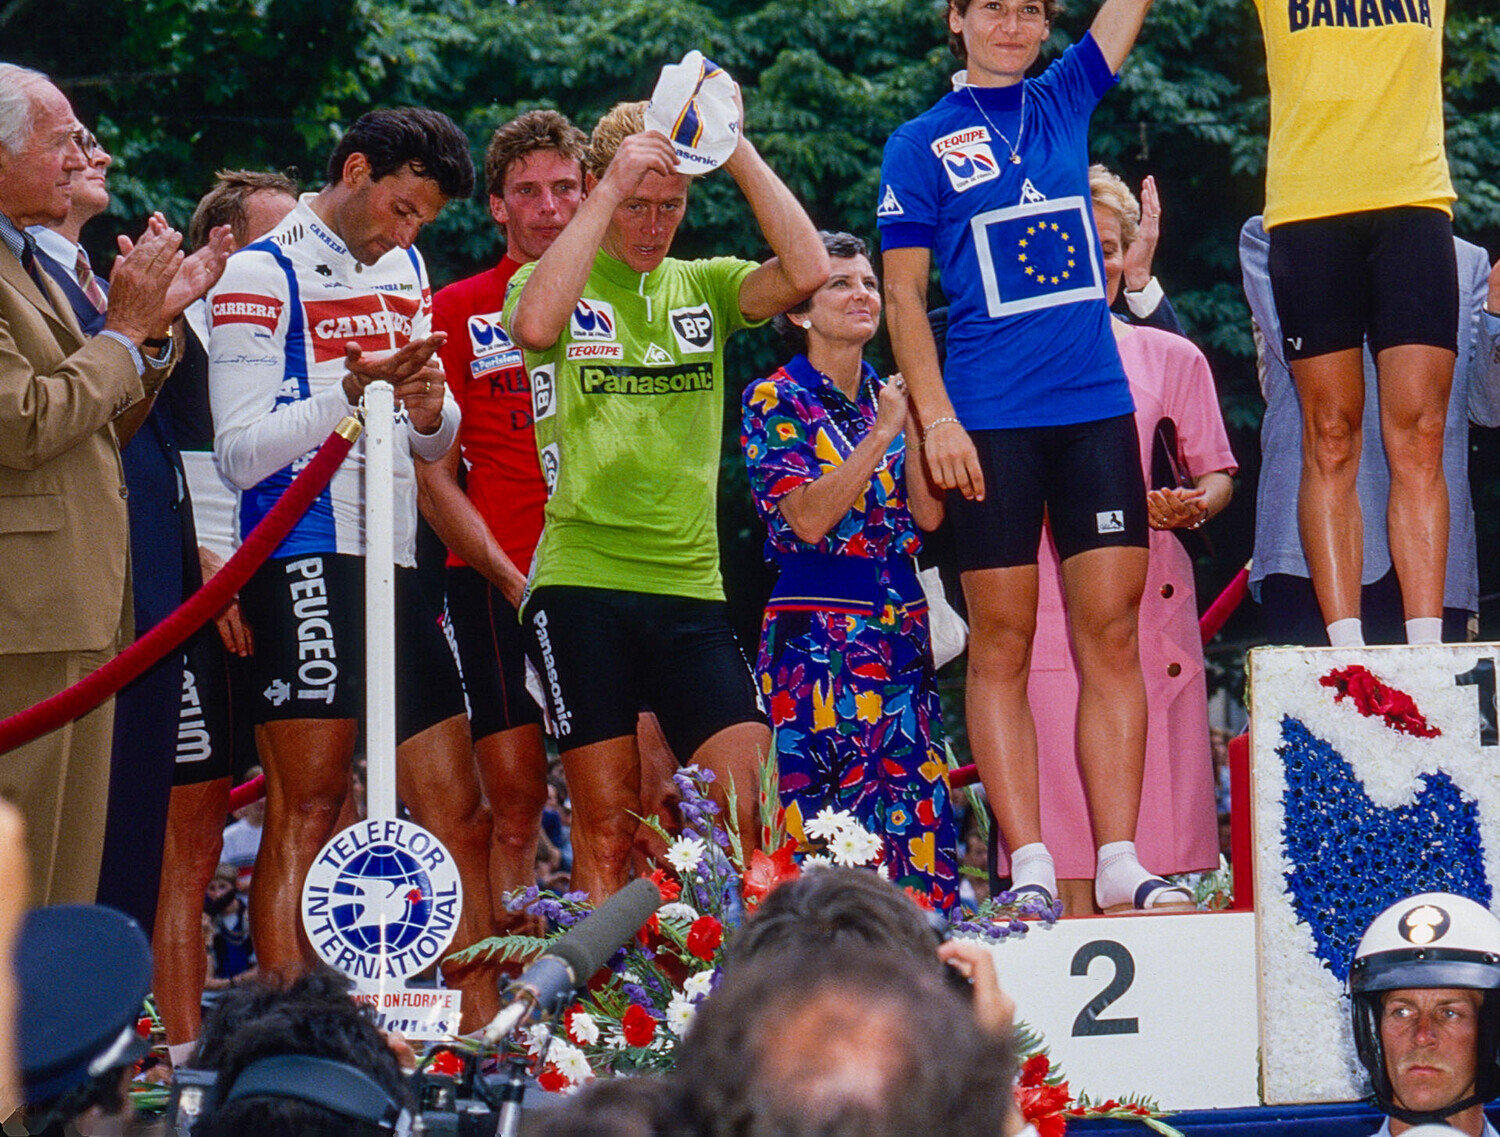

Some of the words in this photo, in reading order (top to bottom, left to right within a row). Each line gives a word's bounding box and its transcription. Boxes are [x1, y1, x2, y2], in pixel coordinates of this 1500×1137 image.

[675, 148, 718, 167] asonic
[935, 129, 985, 154] L'EQUIPE
[212, 302, 278, 319] CARRERA
[679, 316, 711, 339] BP
[568, 345, 620, 358] L'EQUIPE
[535, 373, 551, 410] BP
[584, 365, 713, 393] Panasonic
[286, 556, 338, 705] PEUGEOT
[533, 609, 573, 737] Panasonic
[1455, 657, 1499, 747] 1
[318, 820, 446, 872] TELEFLOR
[308, 880, 458, 980] INTERNATIONAL
[1069, 939, 1139, 1037] 2
